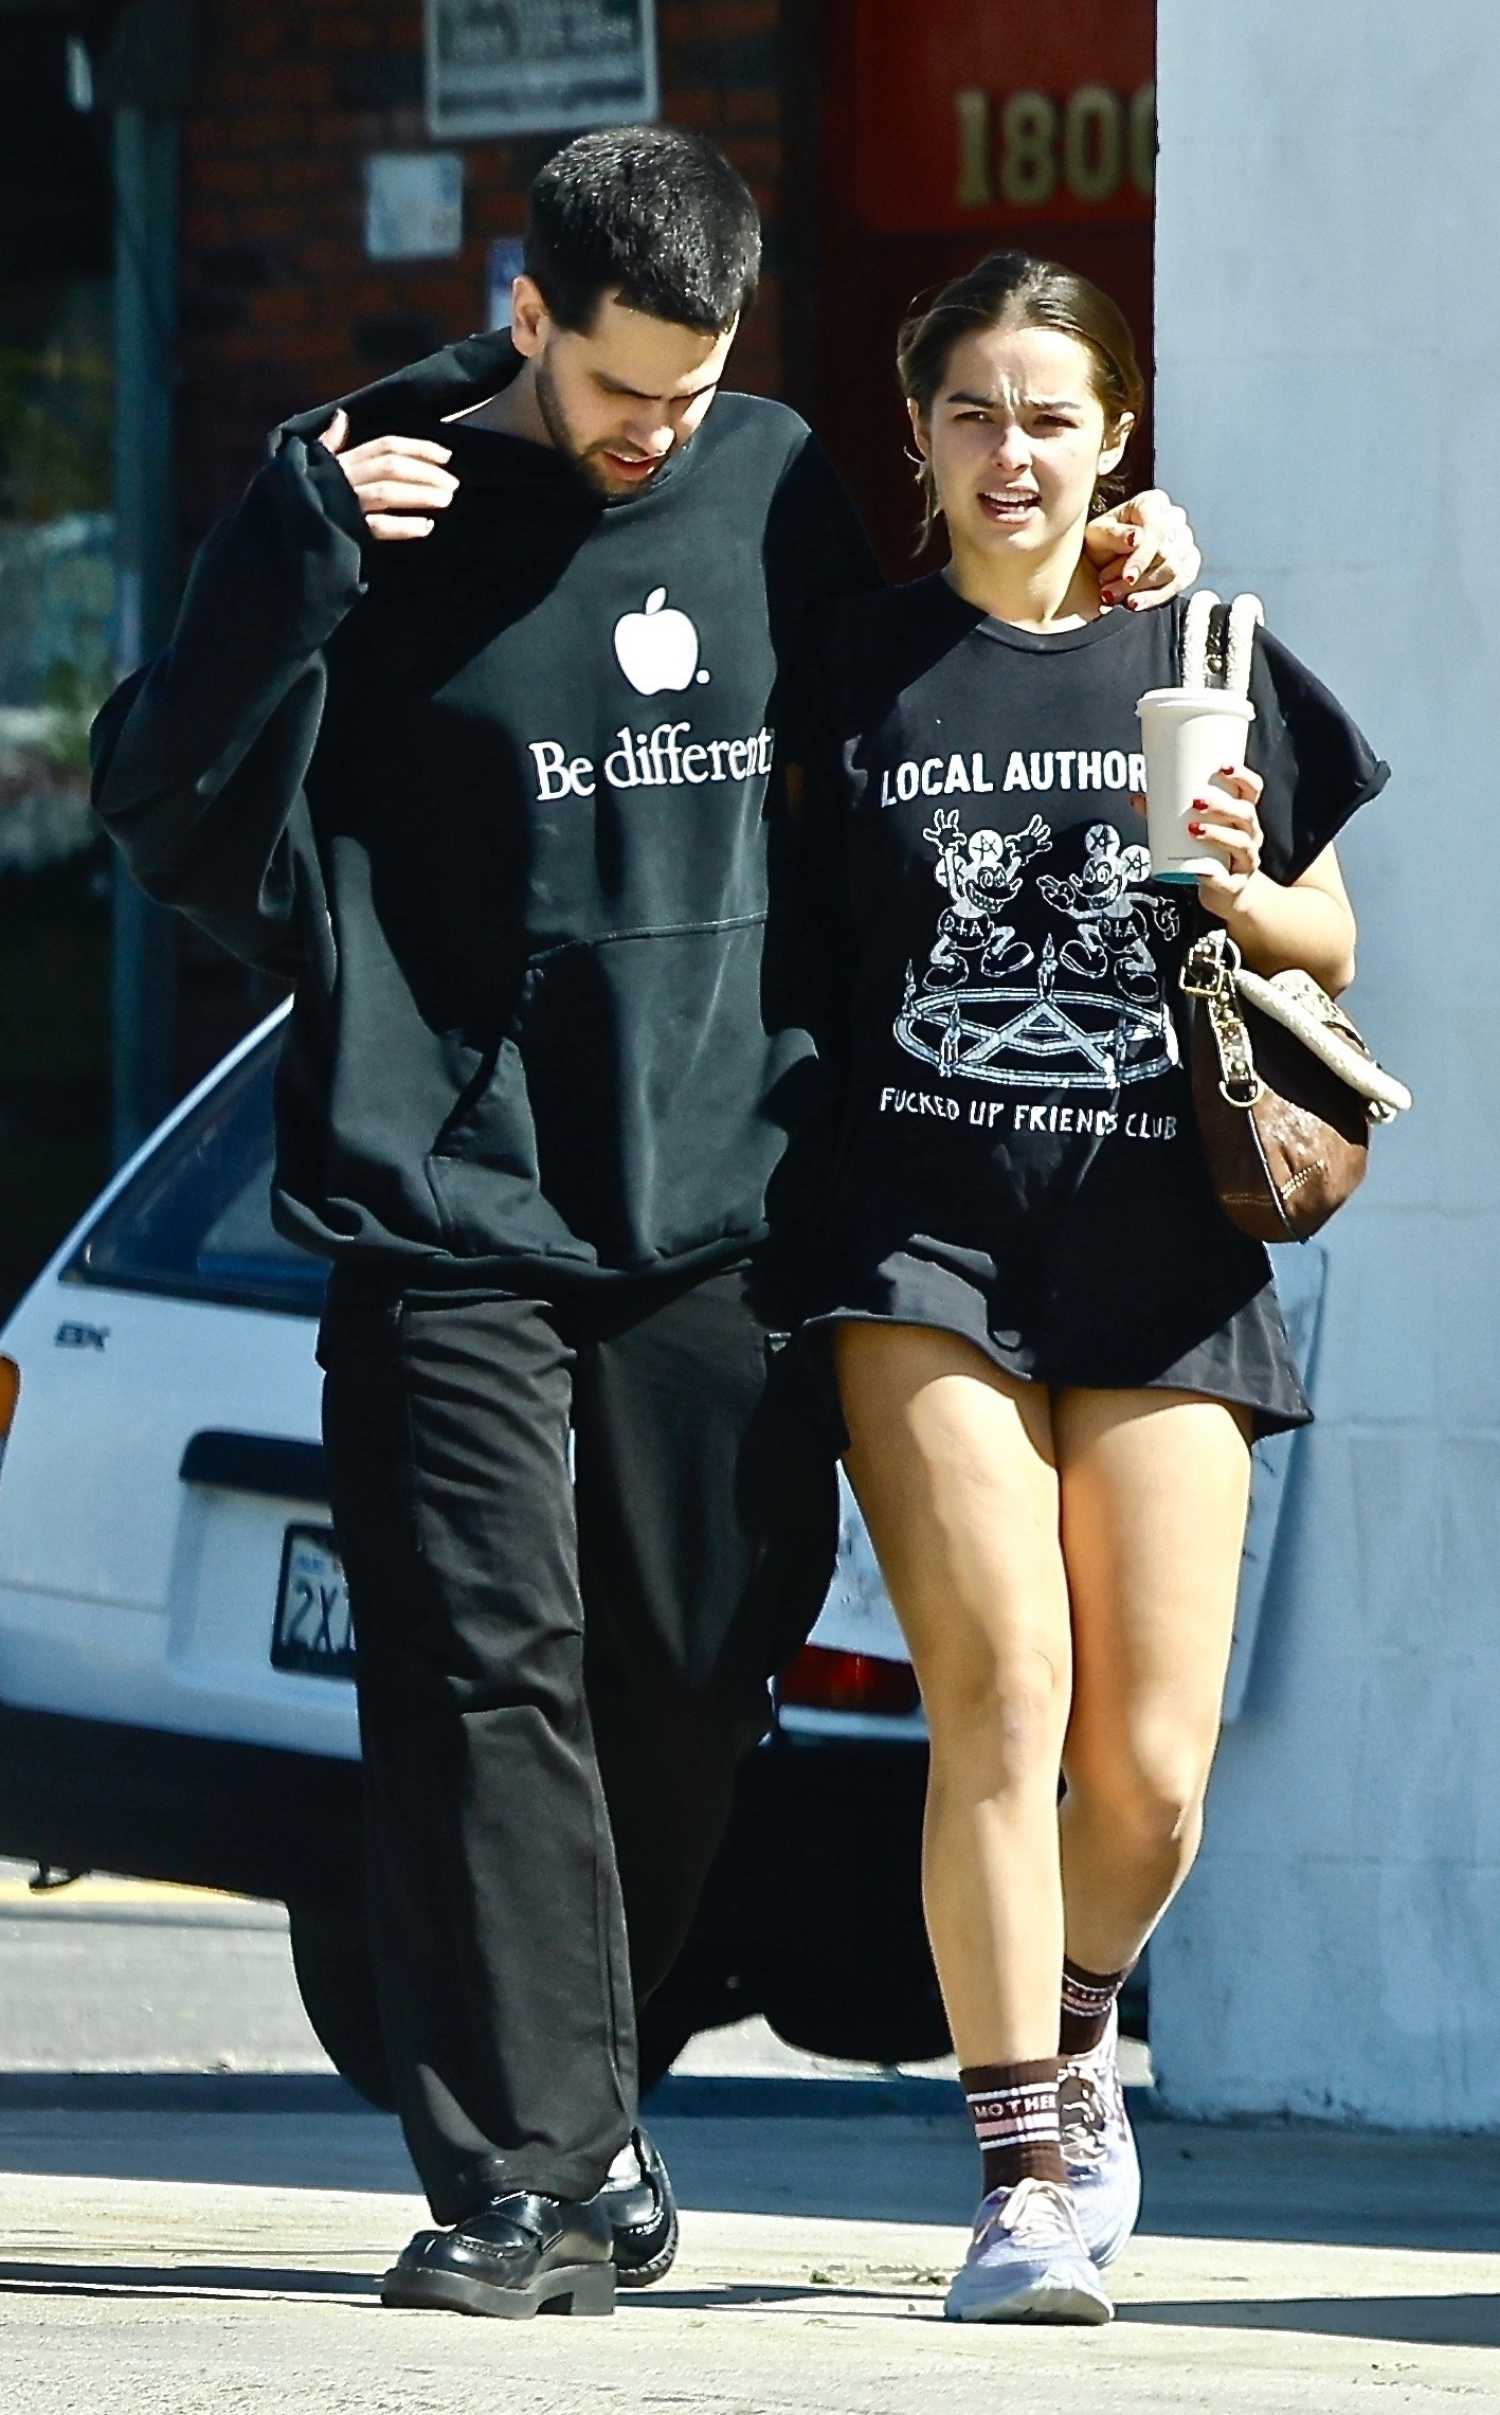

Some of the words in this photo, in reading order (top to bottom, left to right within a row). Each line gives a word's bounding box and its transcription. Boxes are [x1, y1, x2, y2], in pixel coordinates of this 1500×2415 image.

[528, 741, 596, 801] Be
[880, 751, 994, 808] LOCAL
[1002, 750, 1147, 793] AUTHOR
[879, 1087, 960, 1121] FUCKED
[969, 1100, 1005, 1129] UP
[1014, 1104, 1118, 1137] FRIENDS
[1125, 1112, 1177, 1140] CLUB
[288, 1580, 352, 1652] 2X
